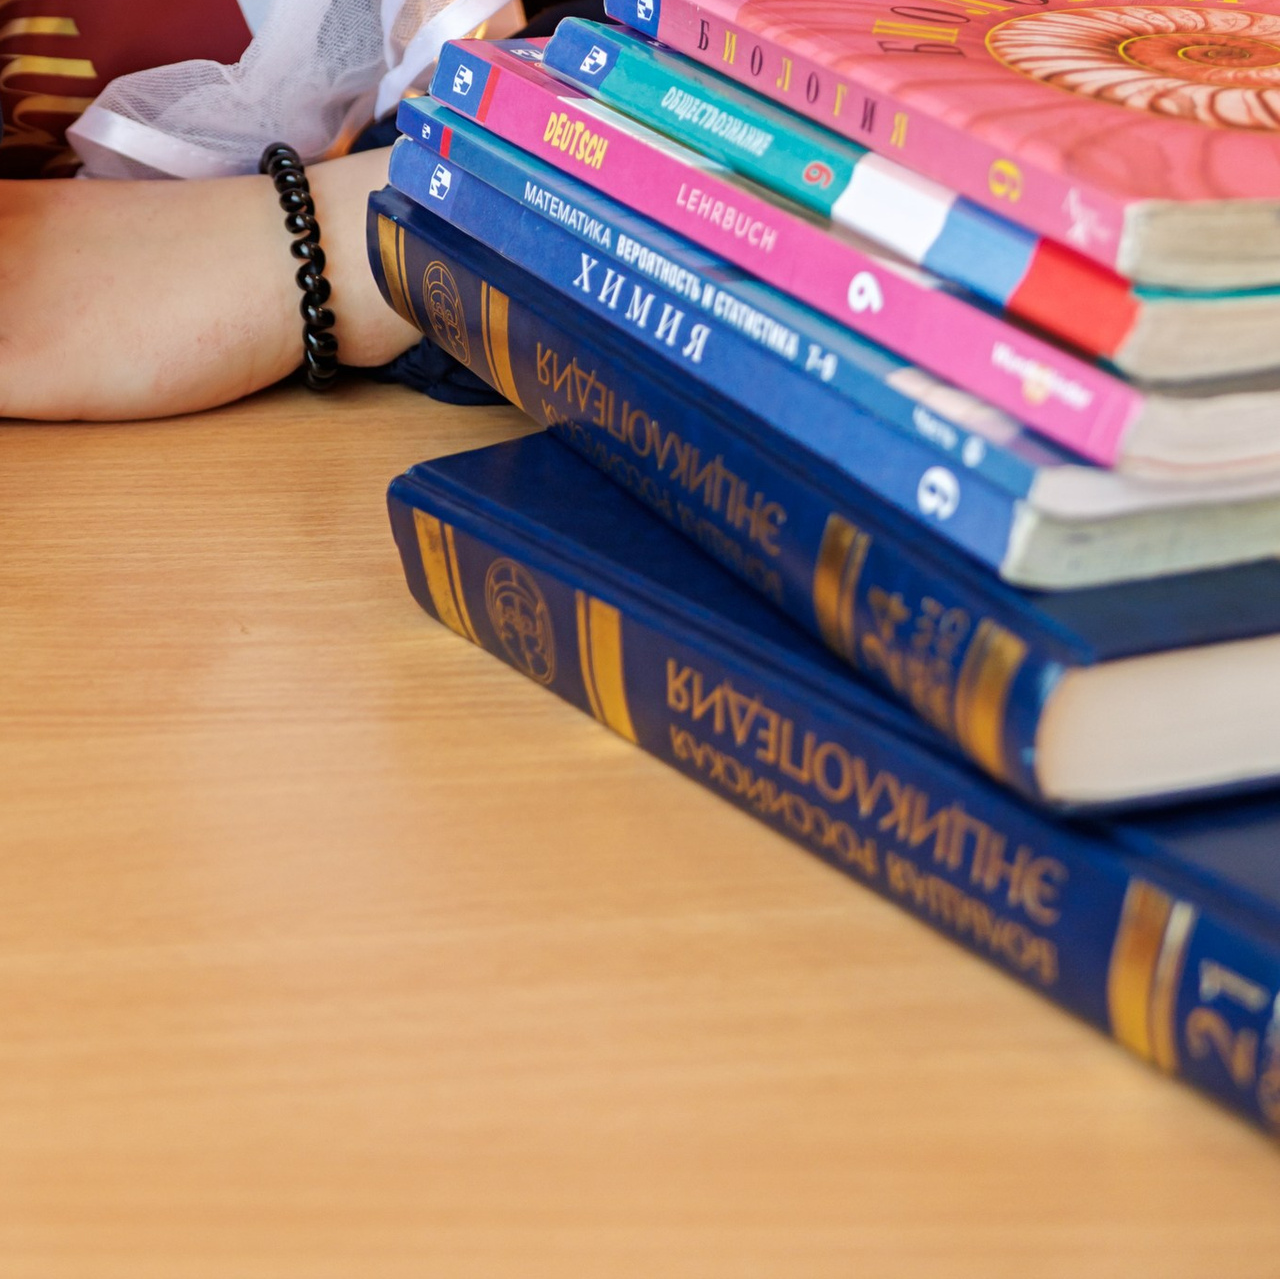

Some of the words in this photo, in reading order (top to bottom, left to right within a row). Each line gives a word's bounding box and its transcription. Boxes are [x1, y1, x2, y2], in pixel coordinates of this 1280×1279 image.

[542, 112, 609, 170] DEUTSCH
[660, 86, 775, 157] ОБЩЕСТВОЗНАНИЕ
[696, 18, 910, 150] БИОЛОГИЯ
[523, 181, 612, 248] МАТЕМАТИКА
[616, 233, 702, 303] ВЕРОЯТНОСТЬ
[701, 283, 715, 307] И
[714, 290, 800, 358] СТАТИСТИКА
[676, 182, 780, 254] LEHRBUCH
[573, 252, 712, 363] ХИМИЯ
[536, 341, 787, 557] ЭНЦИКЛОПЕДИЯ
[666, 657, 1070, 926] ЭНЦИКЛОПЕДИЯ
[669, 722, 880, 877] РОССИЙСКАЯ
[885, 850, 1060, 986] БОЛЬШАЯ
[1185, 958, 1270, 1088] 21
